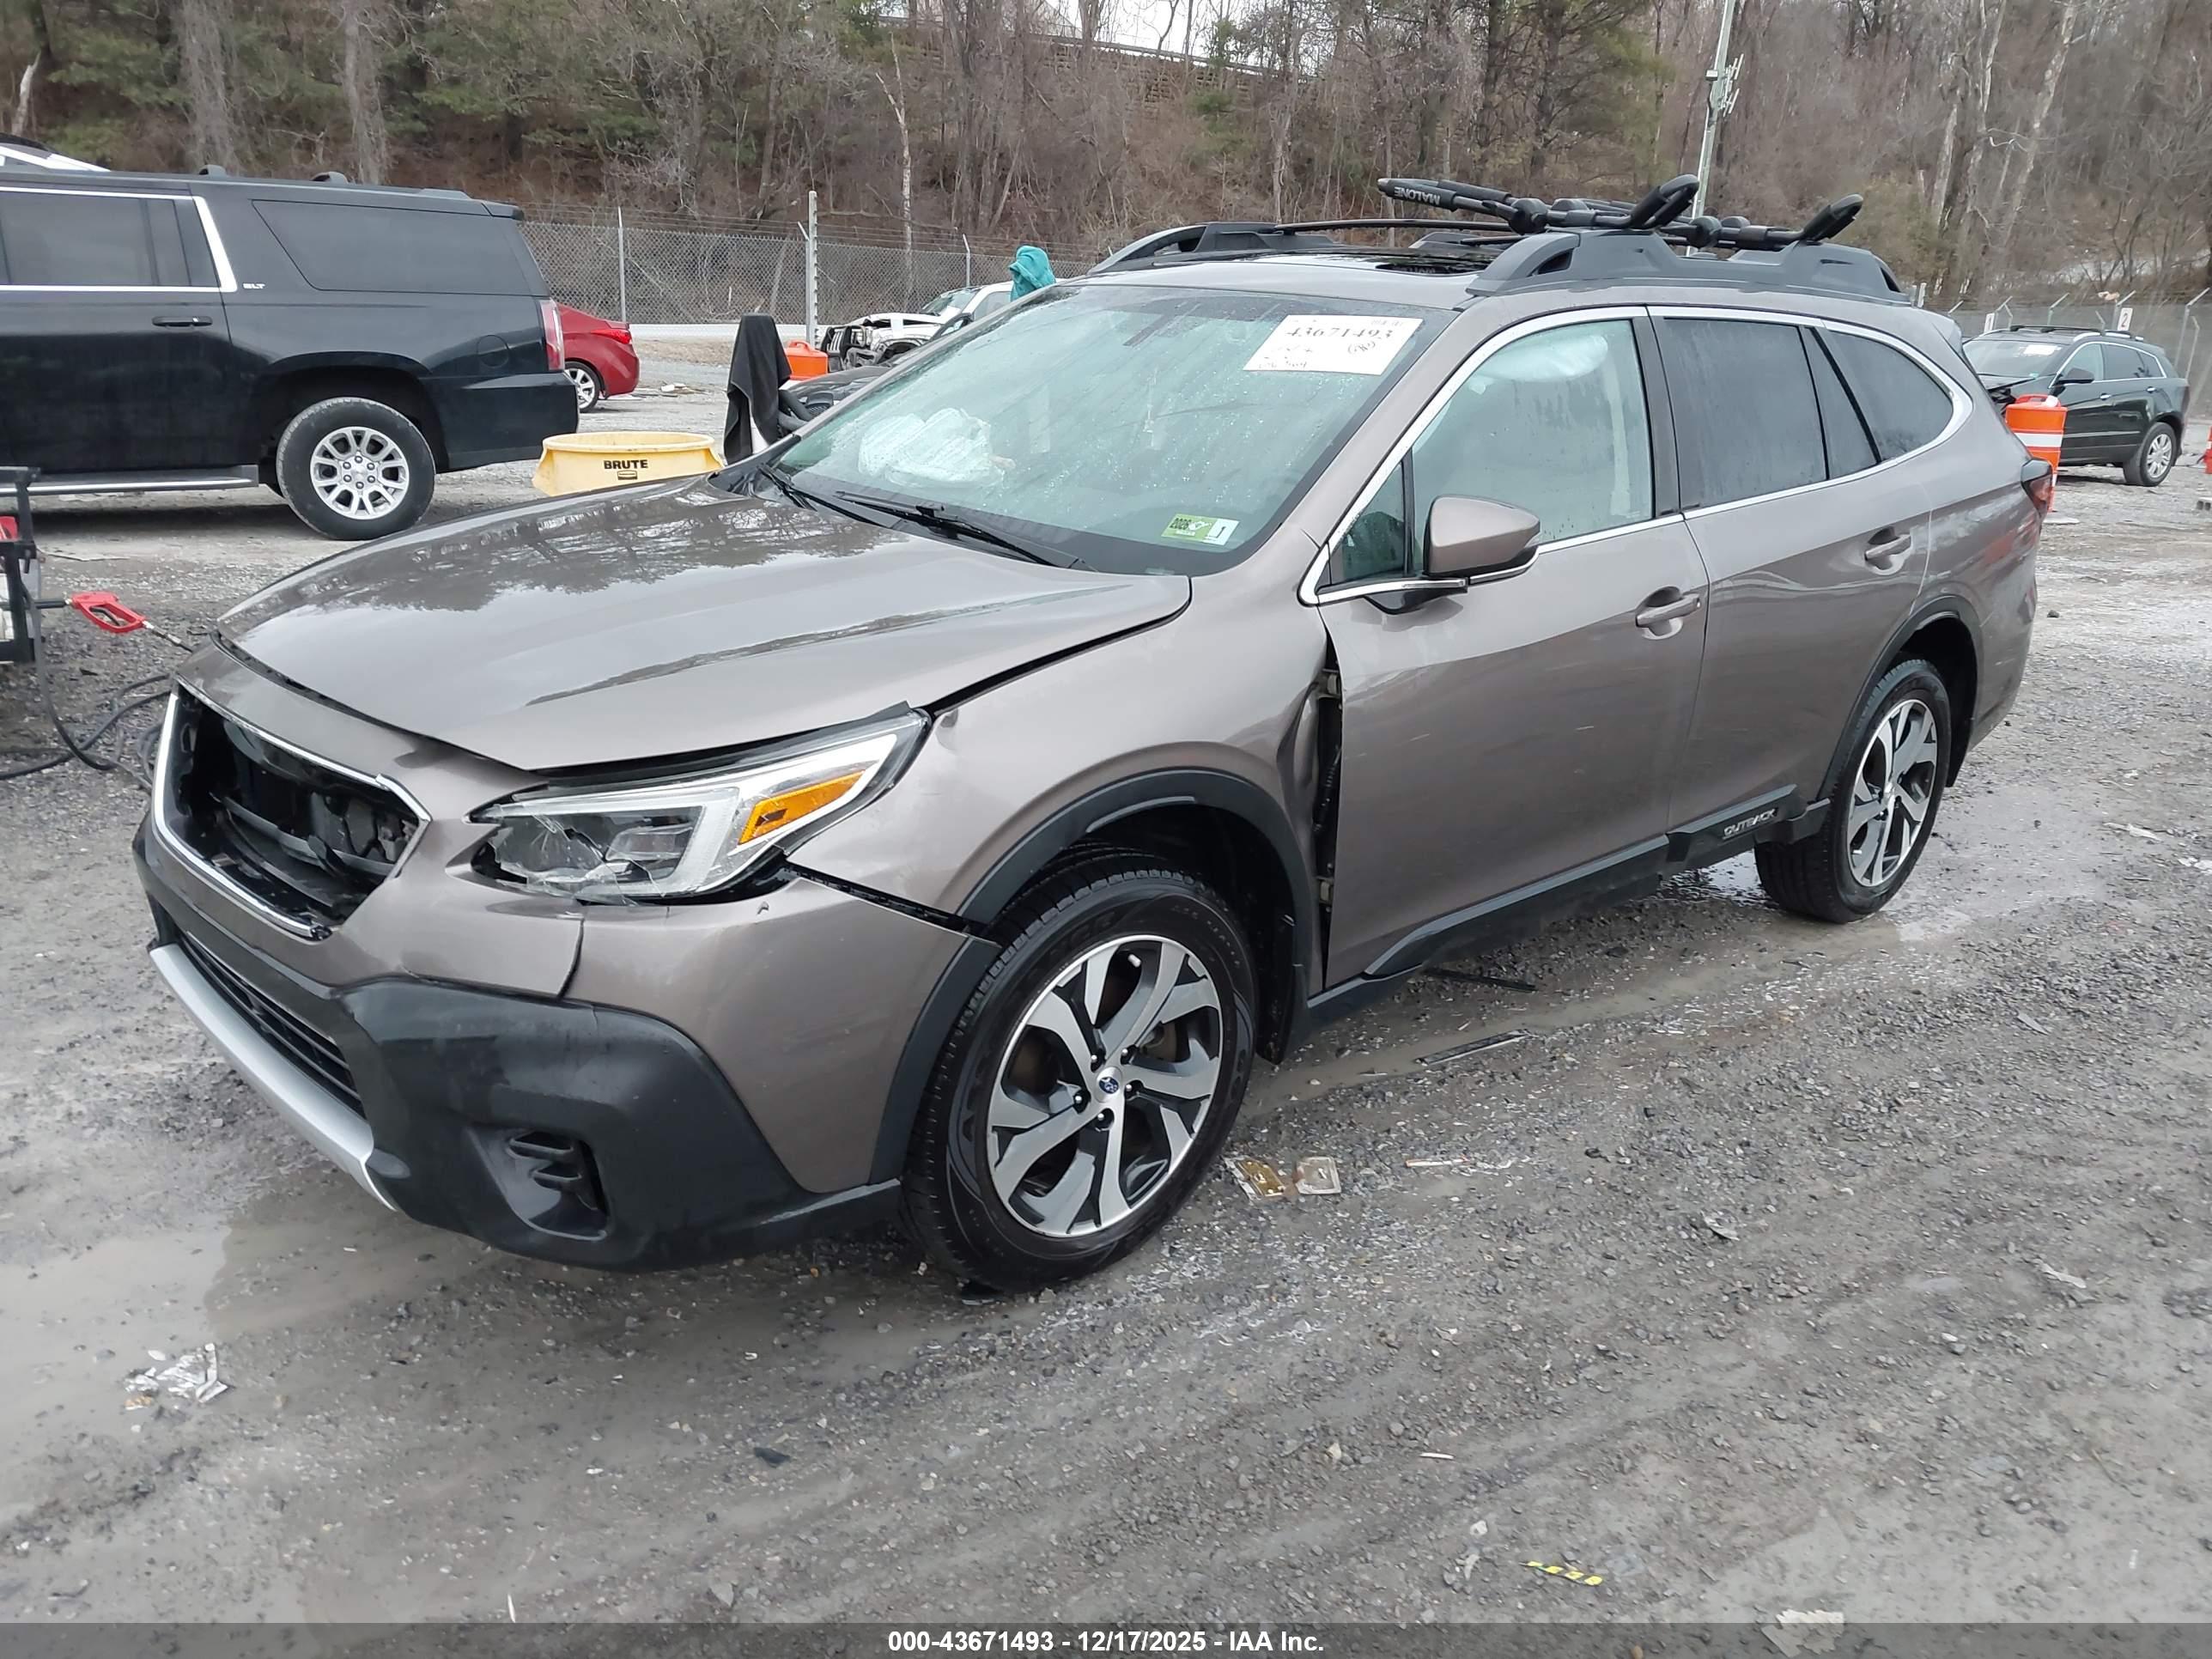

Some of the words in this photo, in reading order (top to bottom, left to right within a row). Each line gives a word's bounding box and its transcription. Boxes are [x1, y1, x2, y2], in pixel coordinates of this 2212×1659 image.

[1394, 186, 1441, 205] MALONE
[604, 459, 648, 470] BRUTE
[1723, 809, 1776, 836] OUTBACK
